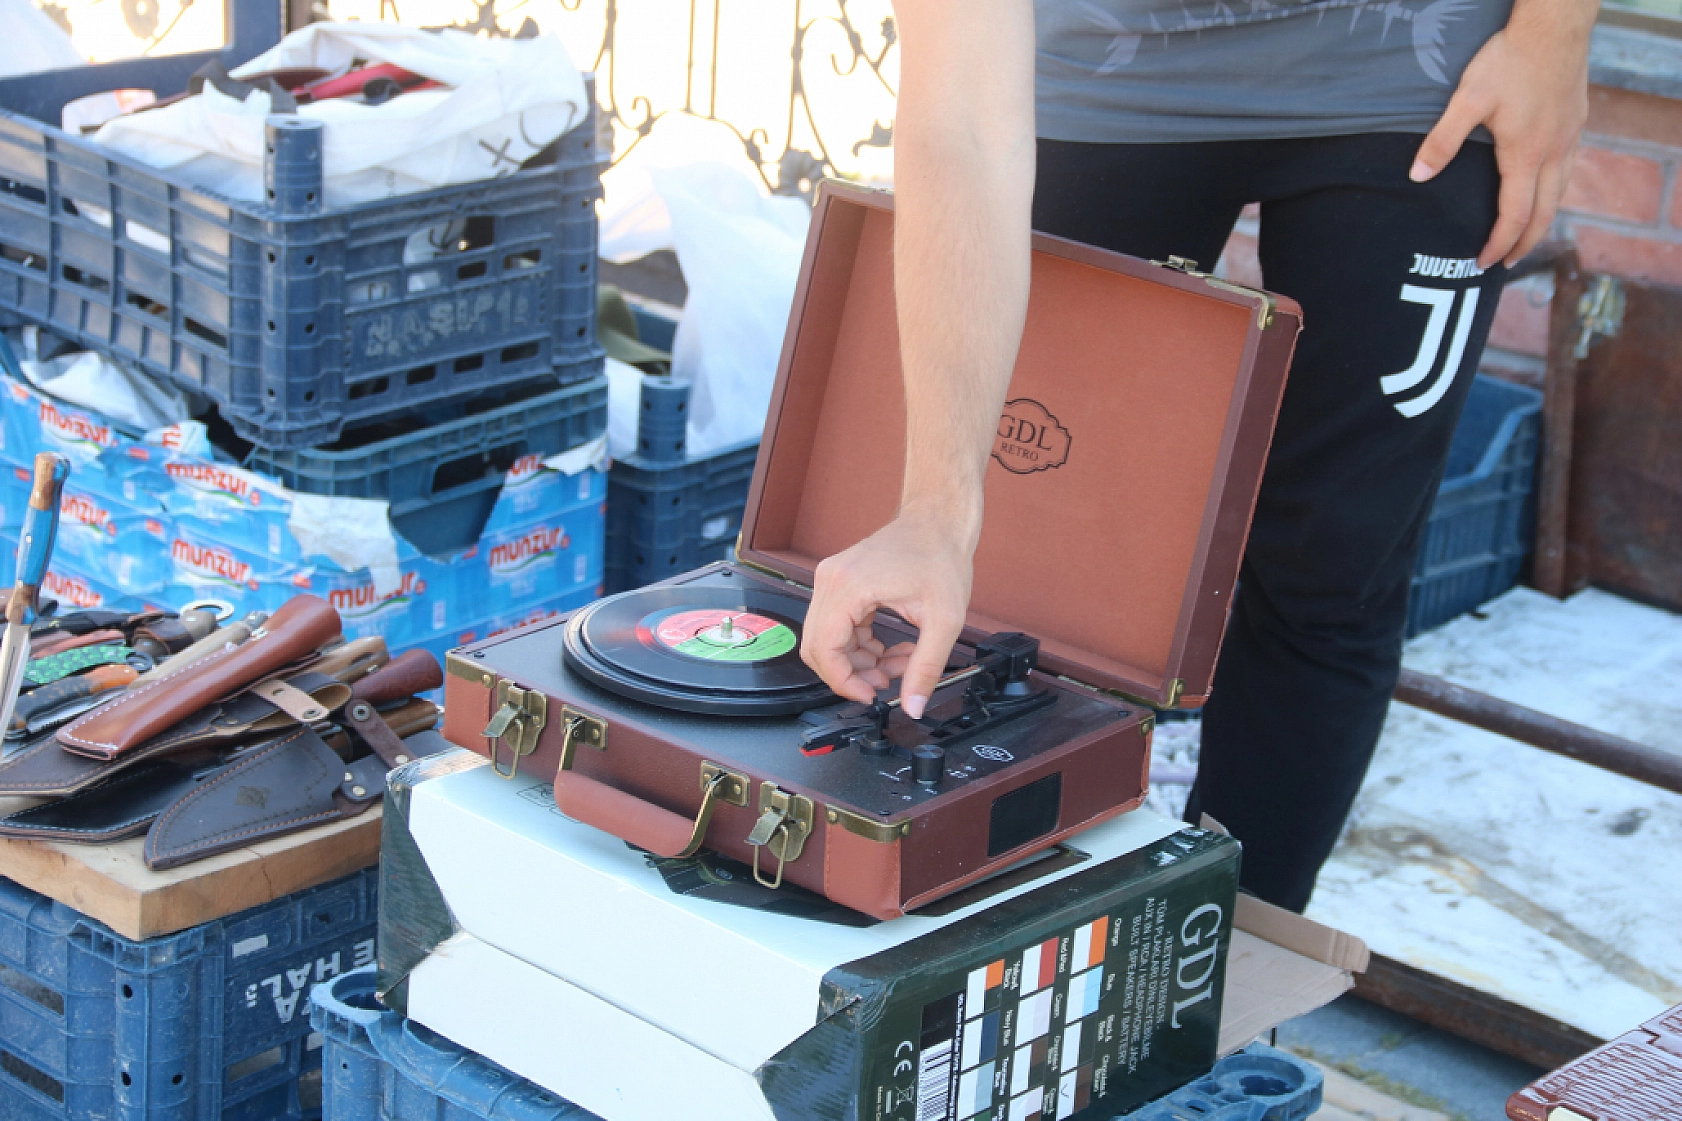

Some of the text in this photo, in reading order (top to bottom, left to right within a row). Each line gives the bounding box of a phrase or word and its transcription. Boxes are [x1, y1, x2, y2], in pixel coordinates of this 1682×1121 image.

[996, 414, 1053, 452] GDL
[1000, 442, 1040, 462] RETRO
[60, 495, 109, 527] unzur
[173, 538, 250, 584] munzur
[491, 527, 564, 567] munzur
[1172, 903, 1223, 1029] GDL
